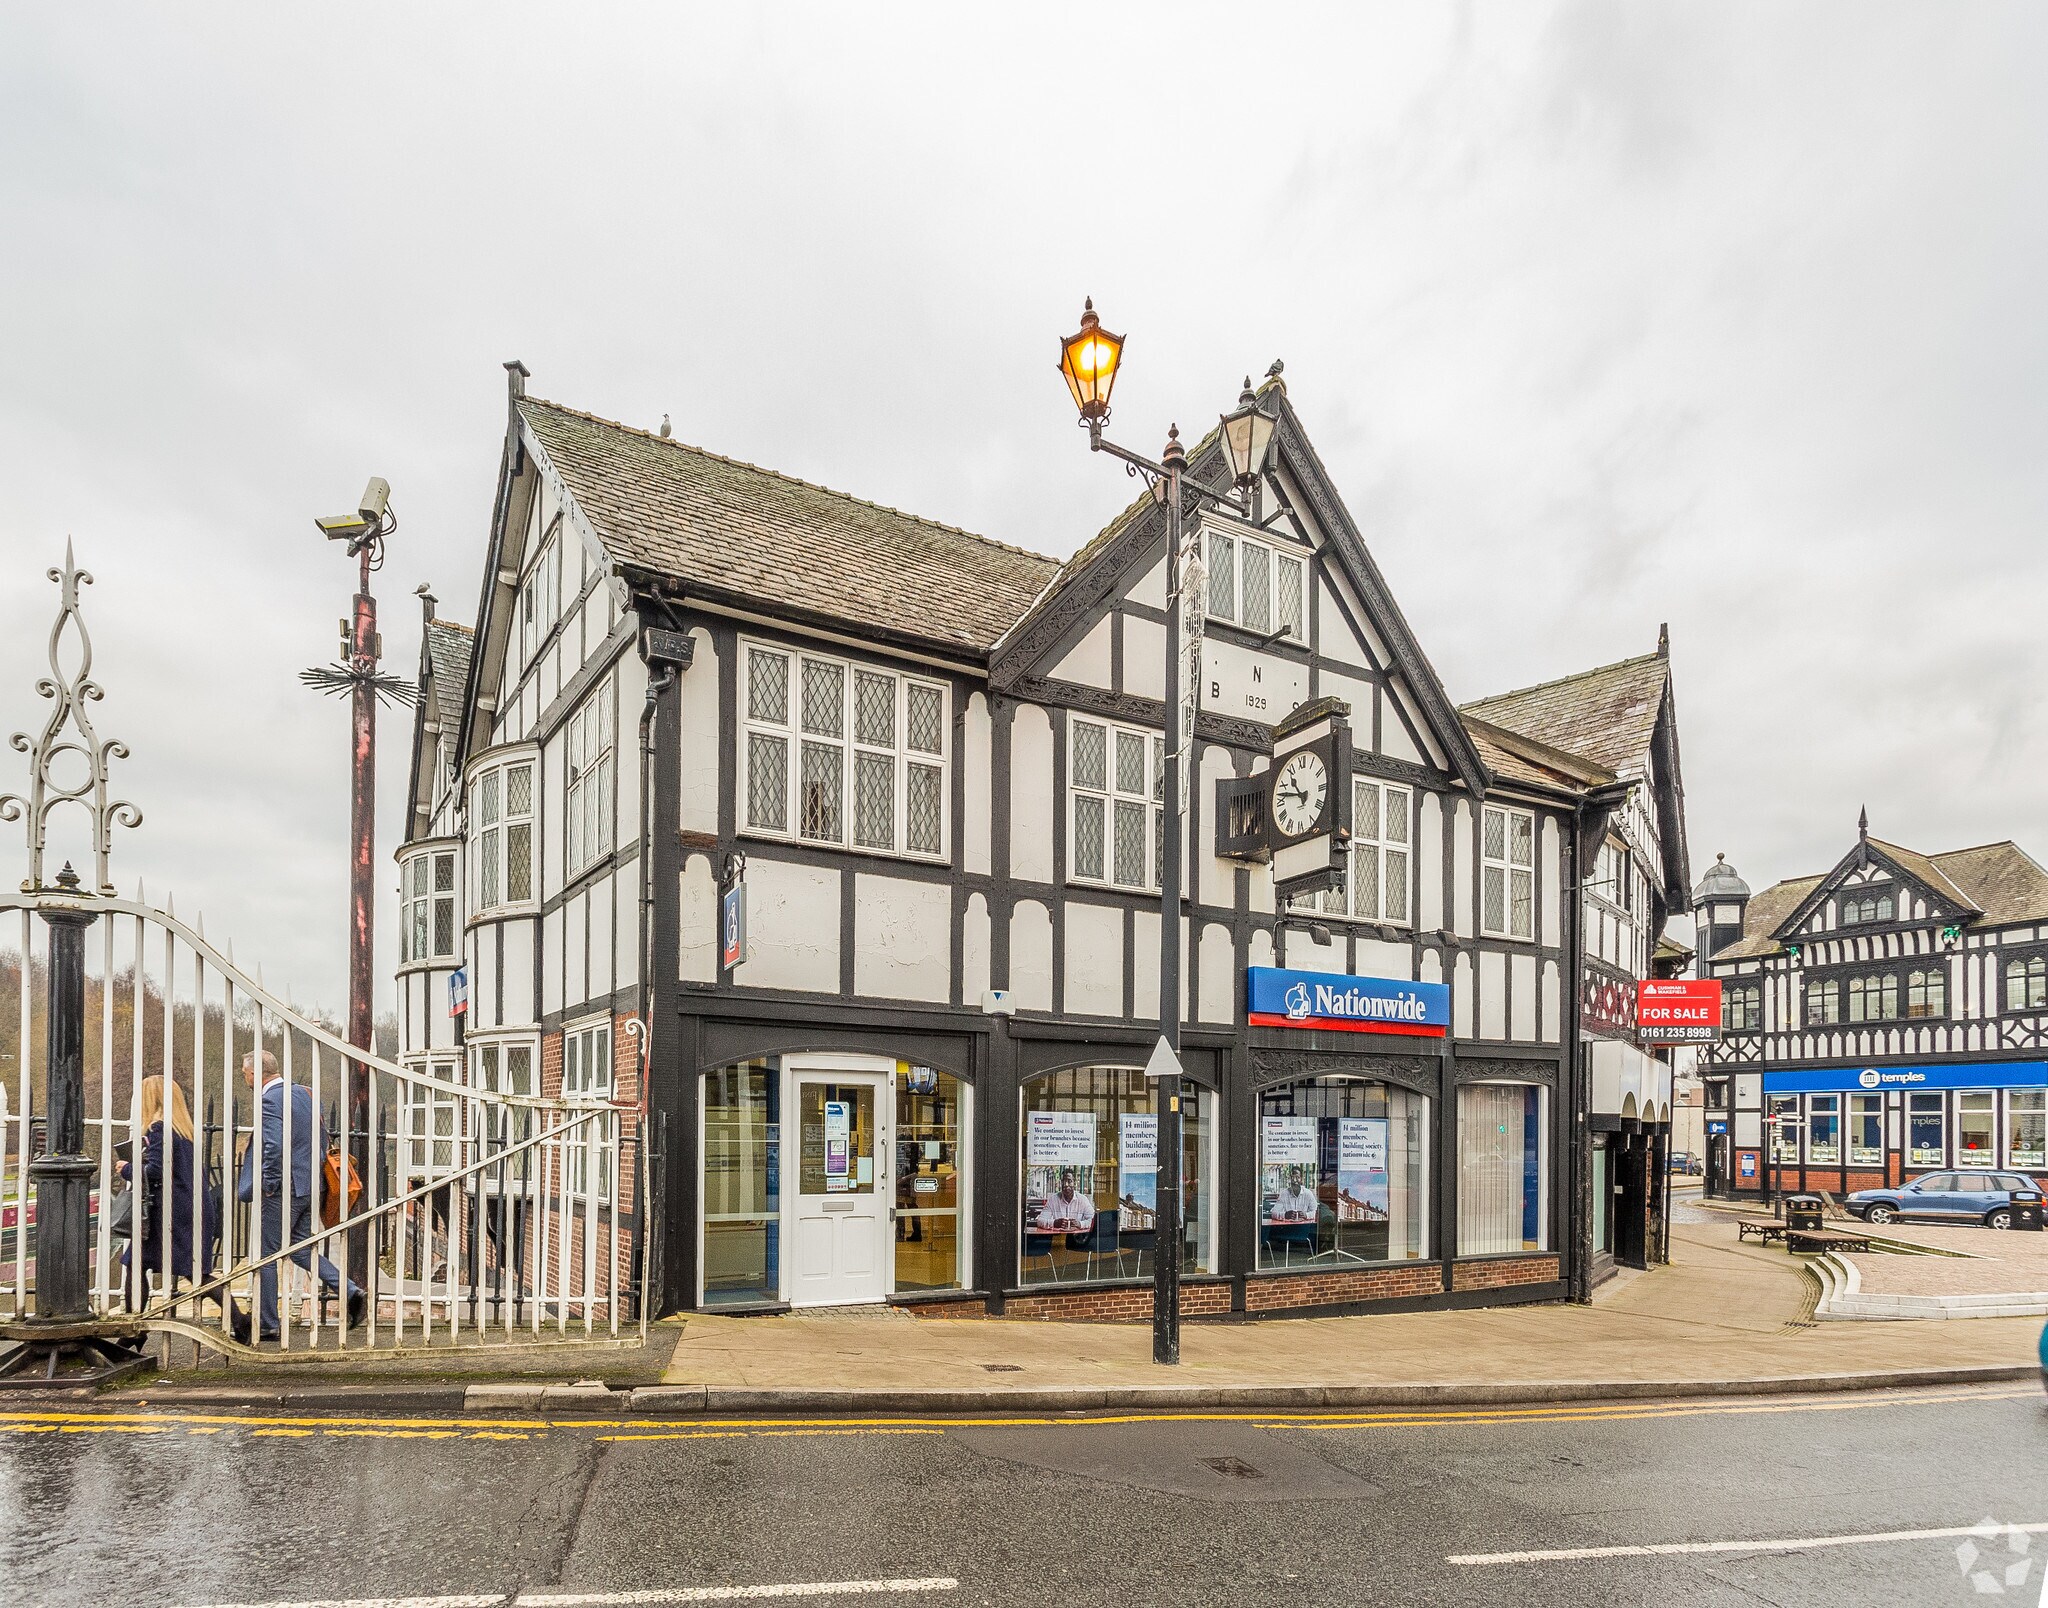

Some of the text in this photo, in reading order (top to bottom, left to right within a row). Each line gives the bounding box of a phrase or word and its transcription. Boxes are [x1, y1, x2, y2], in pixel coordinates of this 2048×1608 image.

[1253, 666, 1262, 683] N
[1211, 681, 1220, 698] B
[1245, 694, 1267, 710] 1929
[1315, 984, 1426, 1021] Nationwide
[1642, 1008, 1709, 1019] FOR SALE
[1640, 1027, 1712, 1038] 0161 235 8998
[1881, 1071, 1926, 1084] temples
[1911, 1116, 1941, 1127] mples
[1126, 1141, 1152, 1149] building
